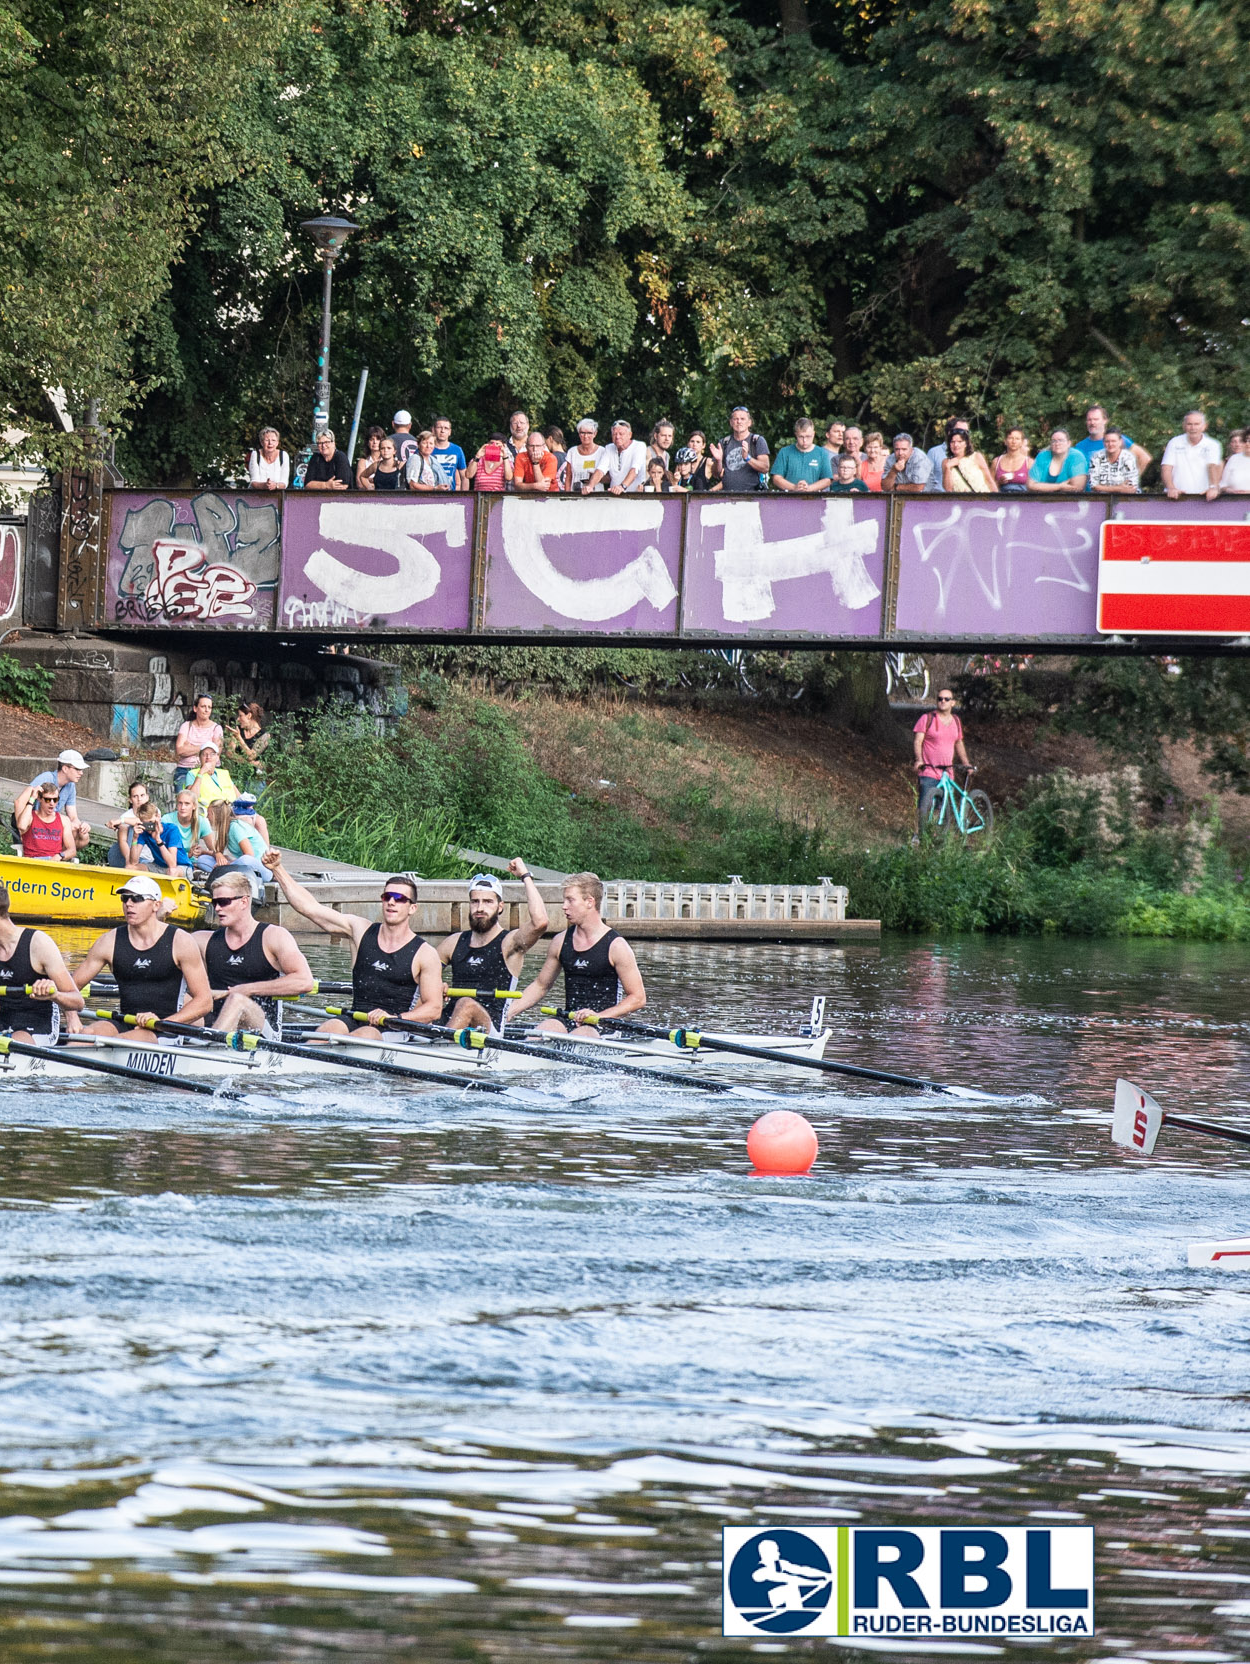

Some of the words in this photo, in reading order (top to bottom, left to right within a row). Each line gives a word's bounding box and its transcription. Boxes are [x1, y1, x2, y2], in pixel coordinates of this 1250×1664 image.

[51, 882, 95, 901] Sport
[814, 998, 823, 1025] 5
[126, 1052, 177, 1075] MINDEN
